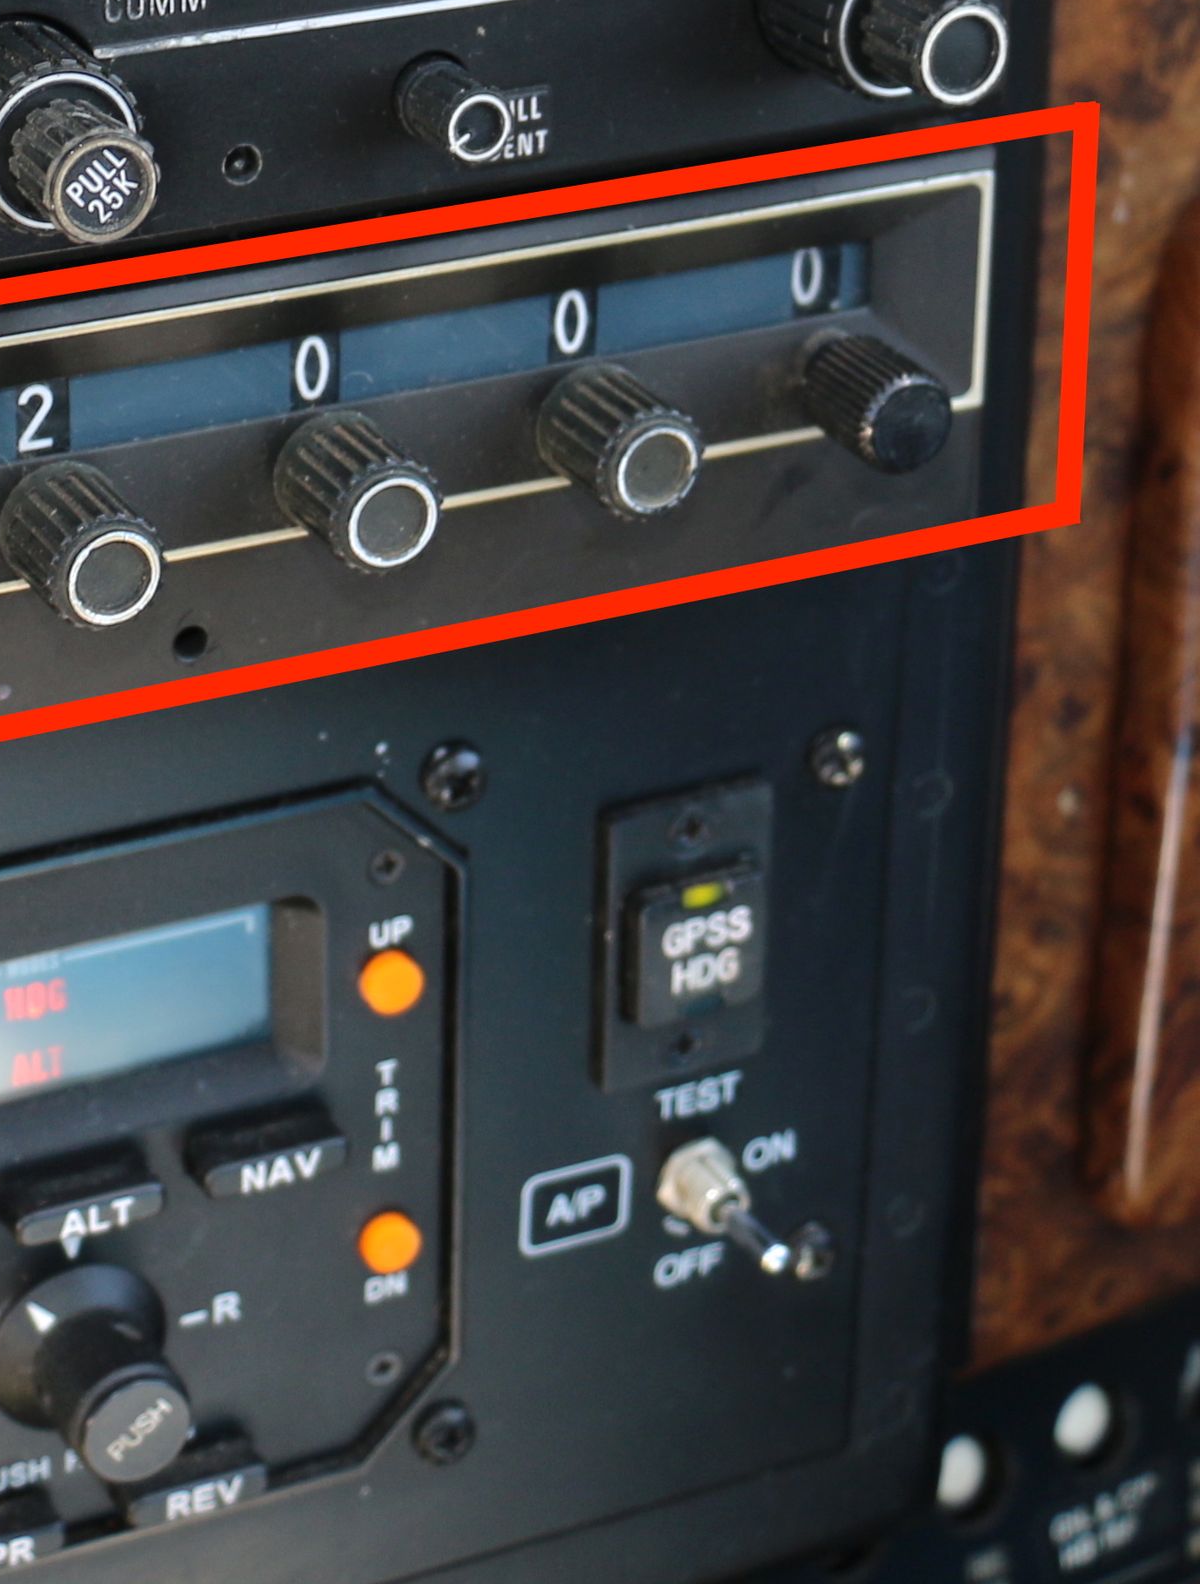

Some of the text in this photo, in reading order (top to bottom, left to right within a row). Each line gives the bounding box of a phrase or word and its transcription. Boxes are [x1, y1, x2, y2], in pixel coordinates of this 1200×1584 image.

[65, 148, 128, 208] PULL
[87, 173, 139, 224] 25K
[17, 247, 822, 453] 2 0 0 0
[368, 915, 414, 950] UP
[661, 905, 752, 959] GPSS
[671, 949, 740, 996] HDG
[372, 1060, 399, 1173] TRIM
[655, 1071, 742, 1121] TEST
[240, 1148, 323, 1195] NAV
[742, 1130, 796, 1173] ON
[60, 1197, 137, 1238] ALT
[547, 1183, 607, 1228] A/P
[364, 1273, 408, 1305] DN
[654, 1242, 725, 1289] OFF
[106, 1397, 173, 1462] PUSH
[166, 1475, 245, 1519] REV
